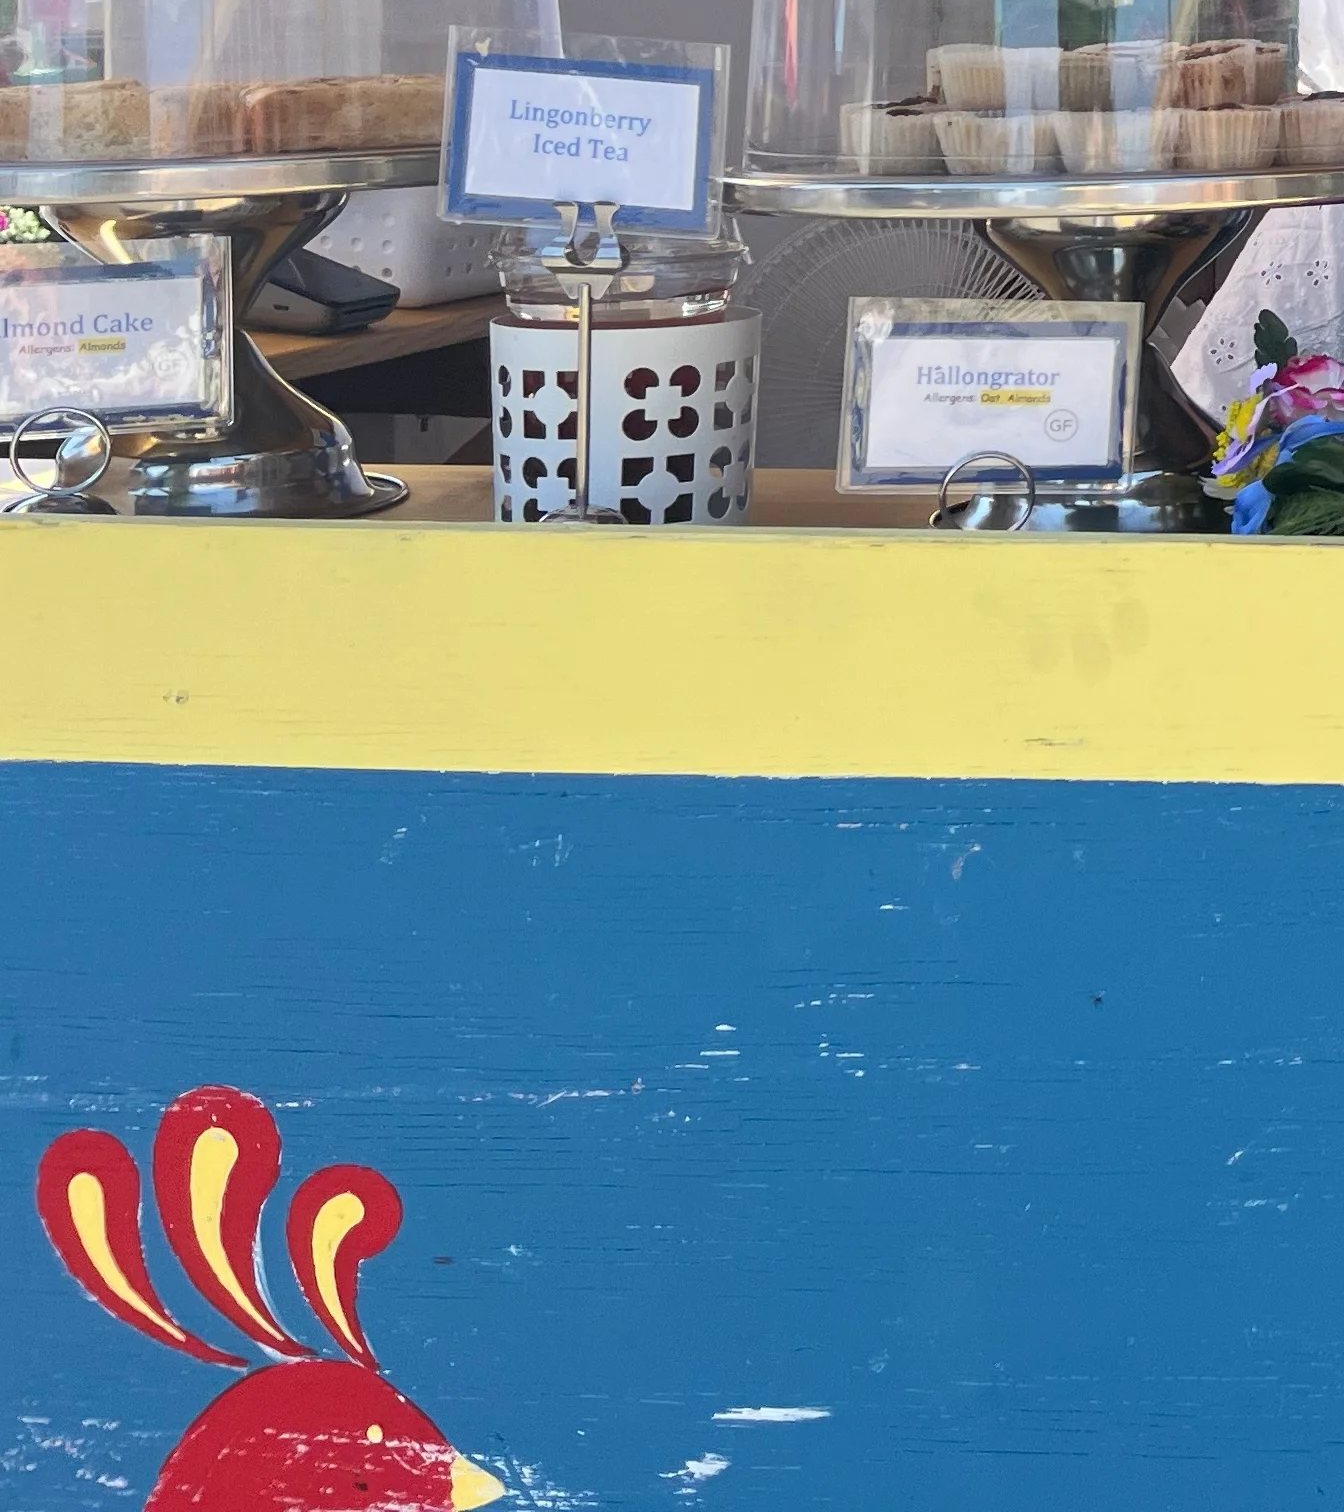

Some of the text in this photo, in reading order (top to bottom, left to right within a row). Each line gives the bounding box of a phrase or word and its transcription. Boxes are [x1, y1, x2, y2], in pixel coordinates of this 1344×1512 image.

[508, 99, 652, 137] Lingonberry
[532, 133, 630, 162] Iced Tea
[0, 312, 154, 339] lmond Cake
[18, 341, 127, 356] Allergens: Almonds
[1049, 419, 1074, 433] GF
